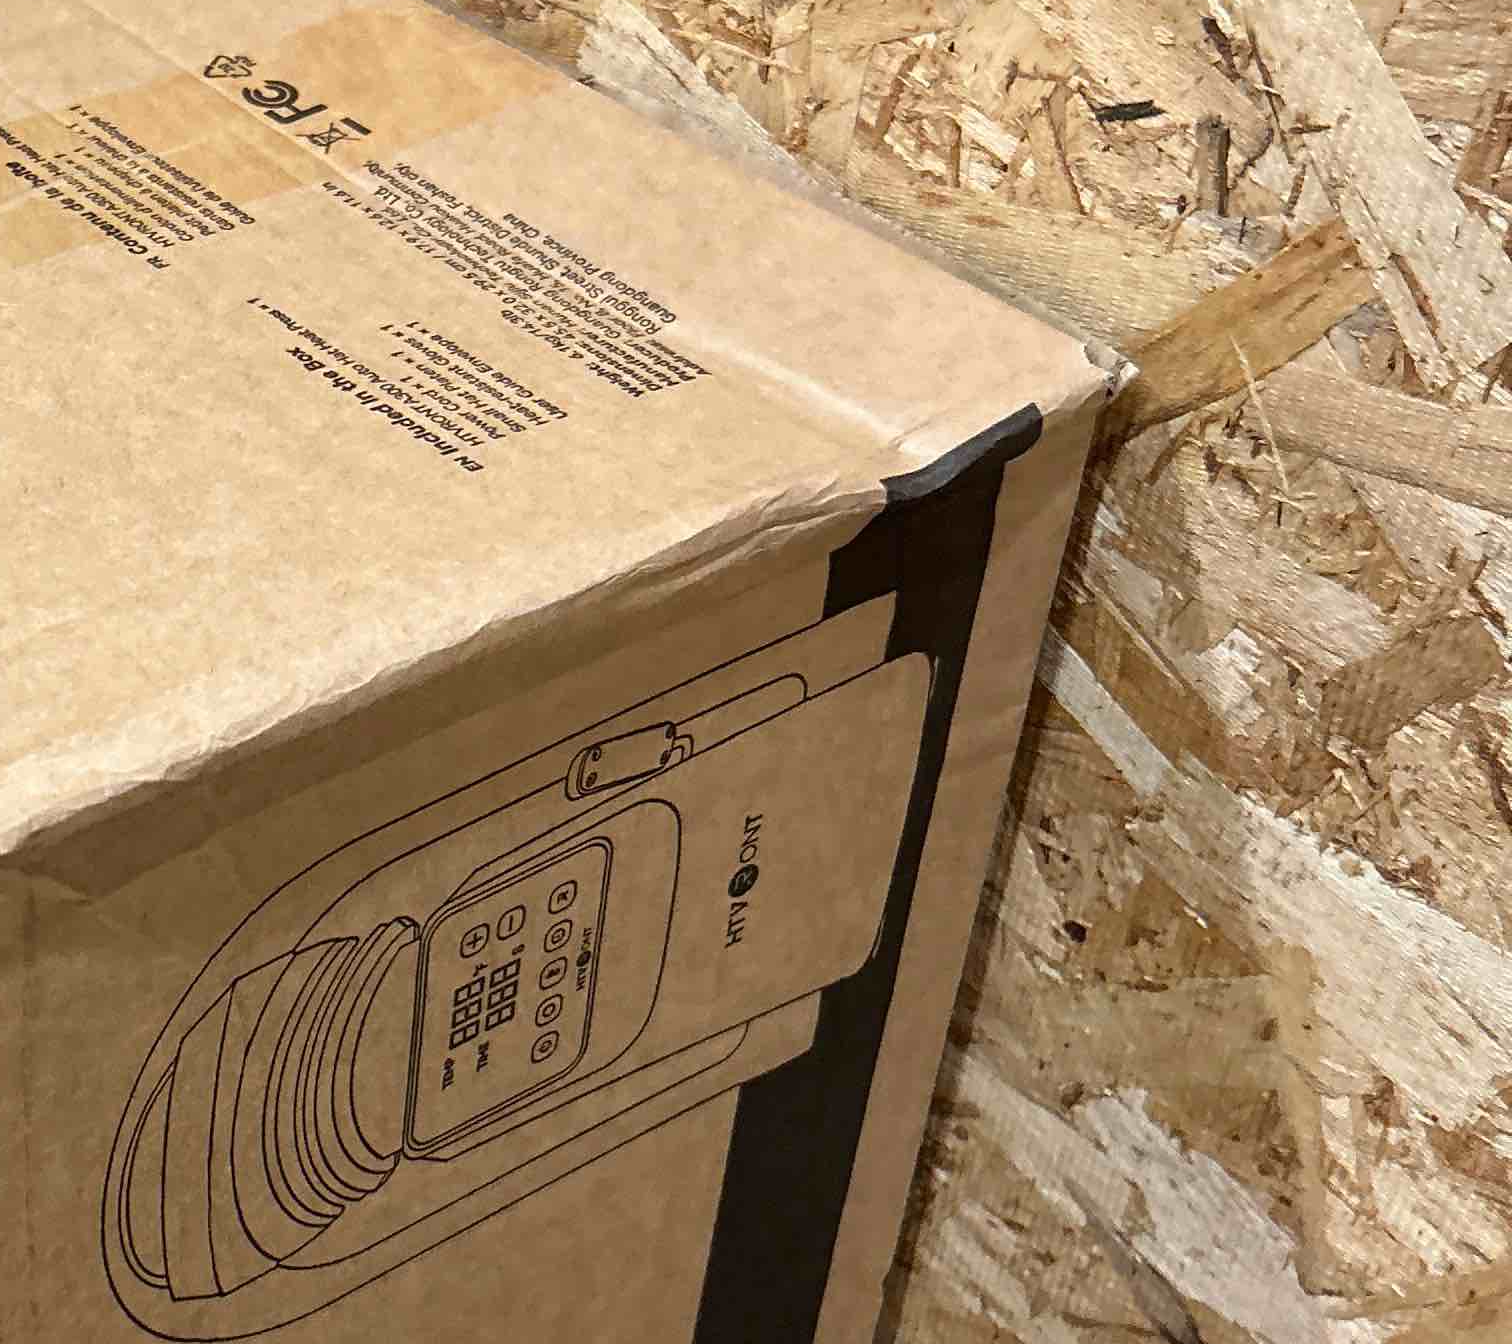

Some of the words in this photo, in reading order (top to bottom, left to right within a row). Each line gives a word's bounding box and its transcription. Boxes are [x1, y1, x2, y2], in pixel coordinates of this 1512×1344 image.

[44, 186, 64, 199] la
[59, 197, 84, 211] de
[372, 184, 402, 205] Ltd.
[416, 178, 464, 209] Foshan
[80, 211, 148, 254] Contenu
[502, 212, 540, 238] China
[422, 215, 495, 263] Technology
[145, 255, 170, 269] FR
[443, 258, 467, 272] cm
[508, 235, 560, 270] Shunde
[493, 259, 544, 292] Rongtu
[598, 270, 677, 323] Guangdong
[542, 289, 621, 339] Guangdong
[297, 328, 332, 350] Heat
[403, 337, 450, 366] Gloves
[285, 346, 326, 371] Box
[326, 347, 356, 366] Hat
[429, 333, 493, 373] Envelope
[322, 369, 357, 391] the
[351, 363, 387, 383] Auto
[414, 363, 461, 392] Platen
[490, 371, 534, 398] Guide
[354, 390, 379, 405] in
[378, 382, 420, 404] A300
[419, 388, 461, 411] Cord
[447, 364, 549, 426] Heat-resistant
[456, 390, 488, 409] Hat
[480, 407, 527, 432] Small
[530, 398, 568, 419] User
[369, 403, 459, 455] Included
[409, 404, 485, 446] HTVRONT
[457, 411, 506, 439] Power
[453, 455, 484, 472] EN
[576, 927, 593, 992] HTVONT
